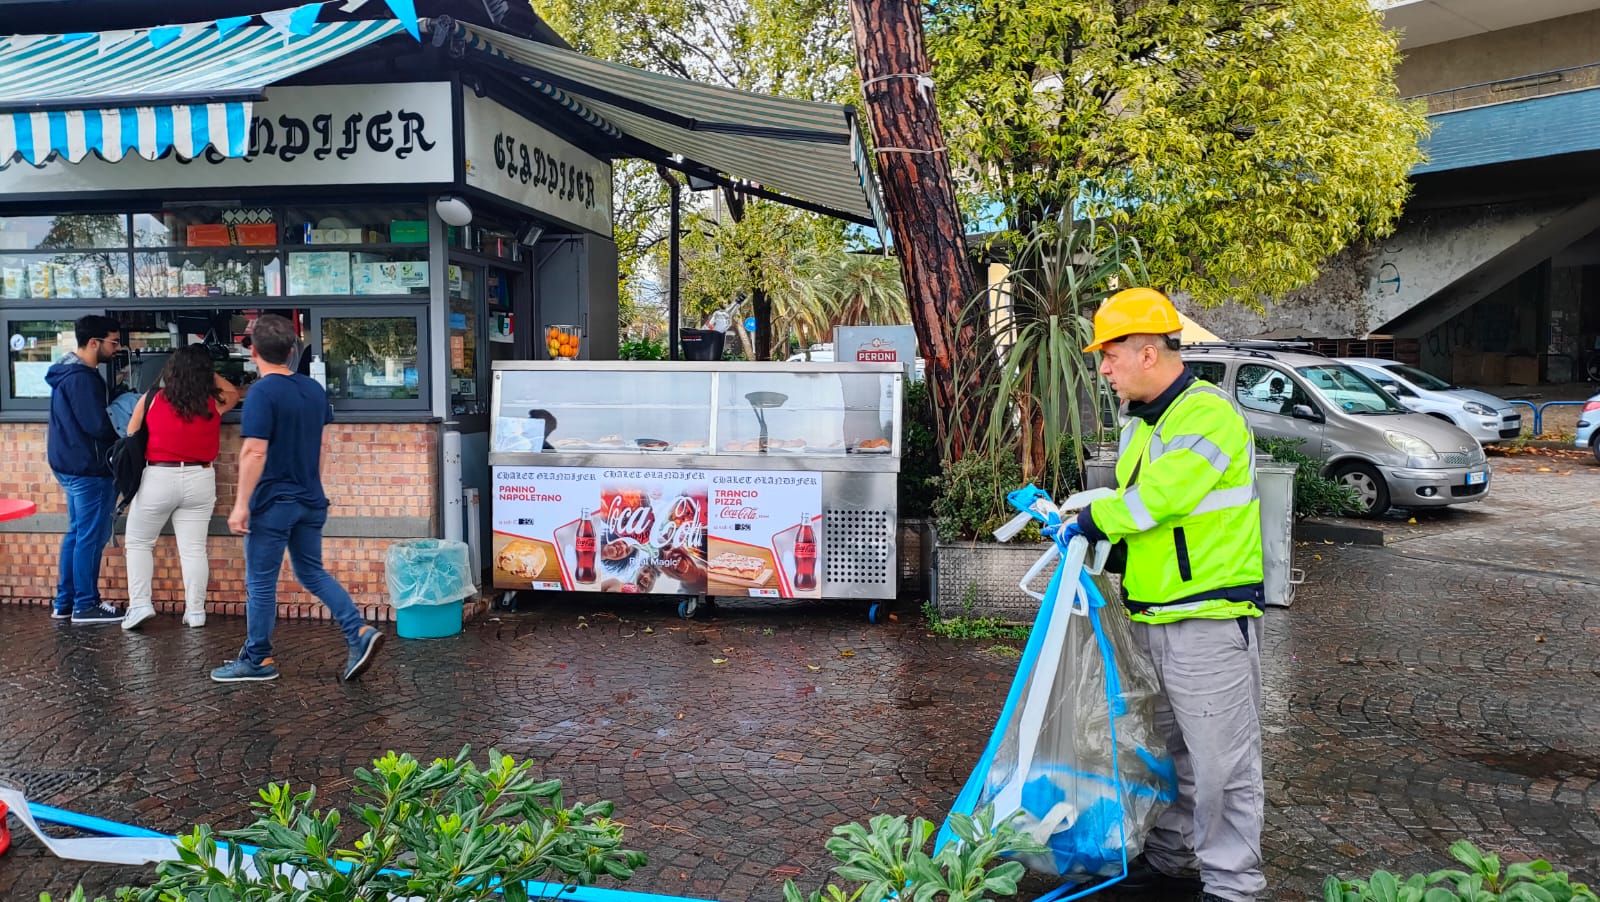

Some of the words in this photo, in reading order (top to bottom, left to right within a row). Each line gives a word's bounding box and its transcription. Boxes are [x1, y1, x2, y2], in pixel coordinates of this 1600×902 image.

[493, 131, 596, 210] GLANDIFER
[859, 352, 895, 361] PERONI
[496, 471, 535, 480] CHALET
[536, 472, 597, 482] GLANDIFER
[603, 470, 641, 479] CHALET
[643, 471, 706, 481] GLANDIFER
[712, 475, 752, 485] CHALET
[754, 476, 817, 486] GLANDIFER
[499, 485, 536, 494] PANINO
[714, 489, 758, 498] TRANCIO
[499, 493, 562, 502] NAPOLETANO
[714, 498, 743, 506] PIZZA
[650, 557, 678, 568] Magic
